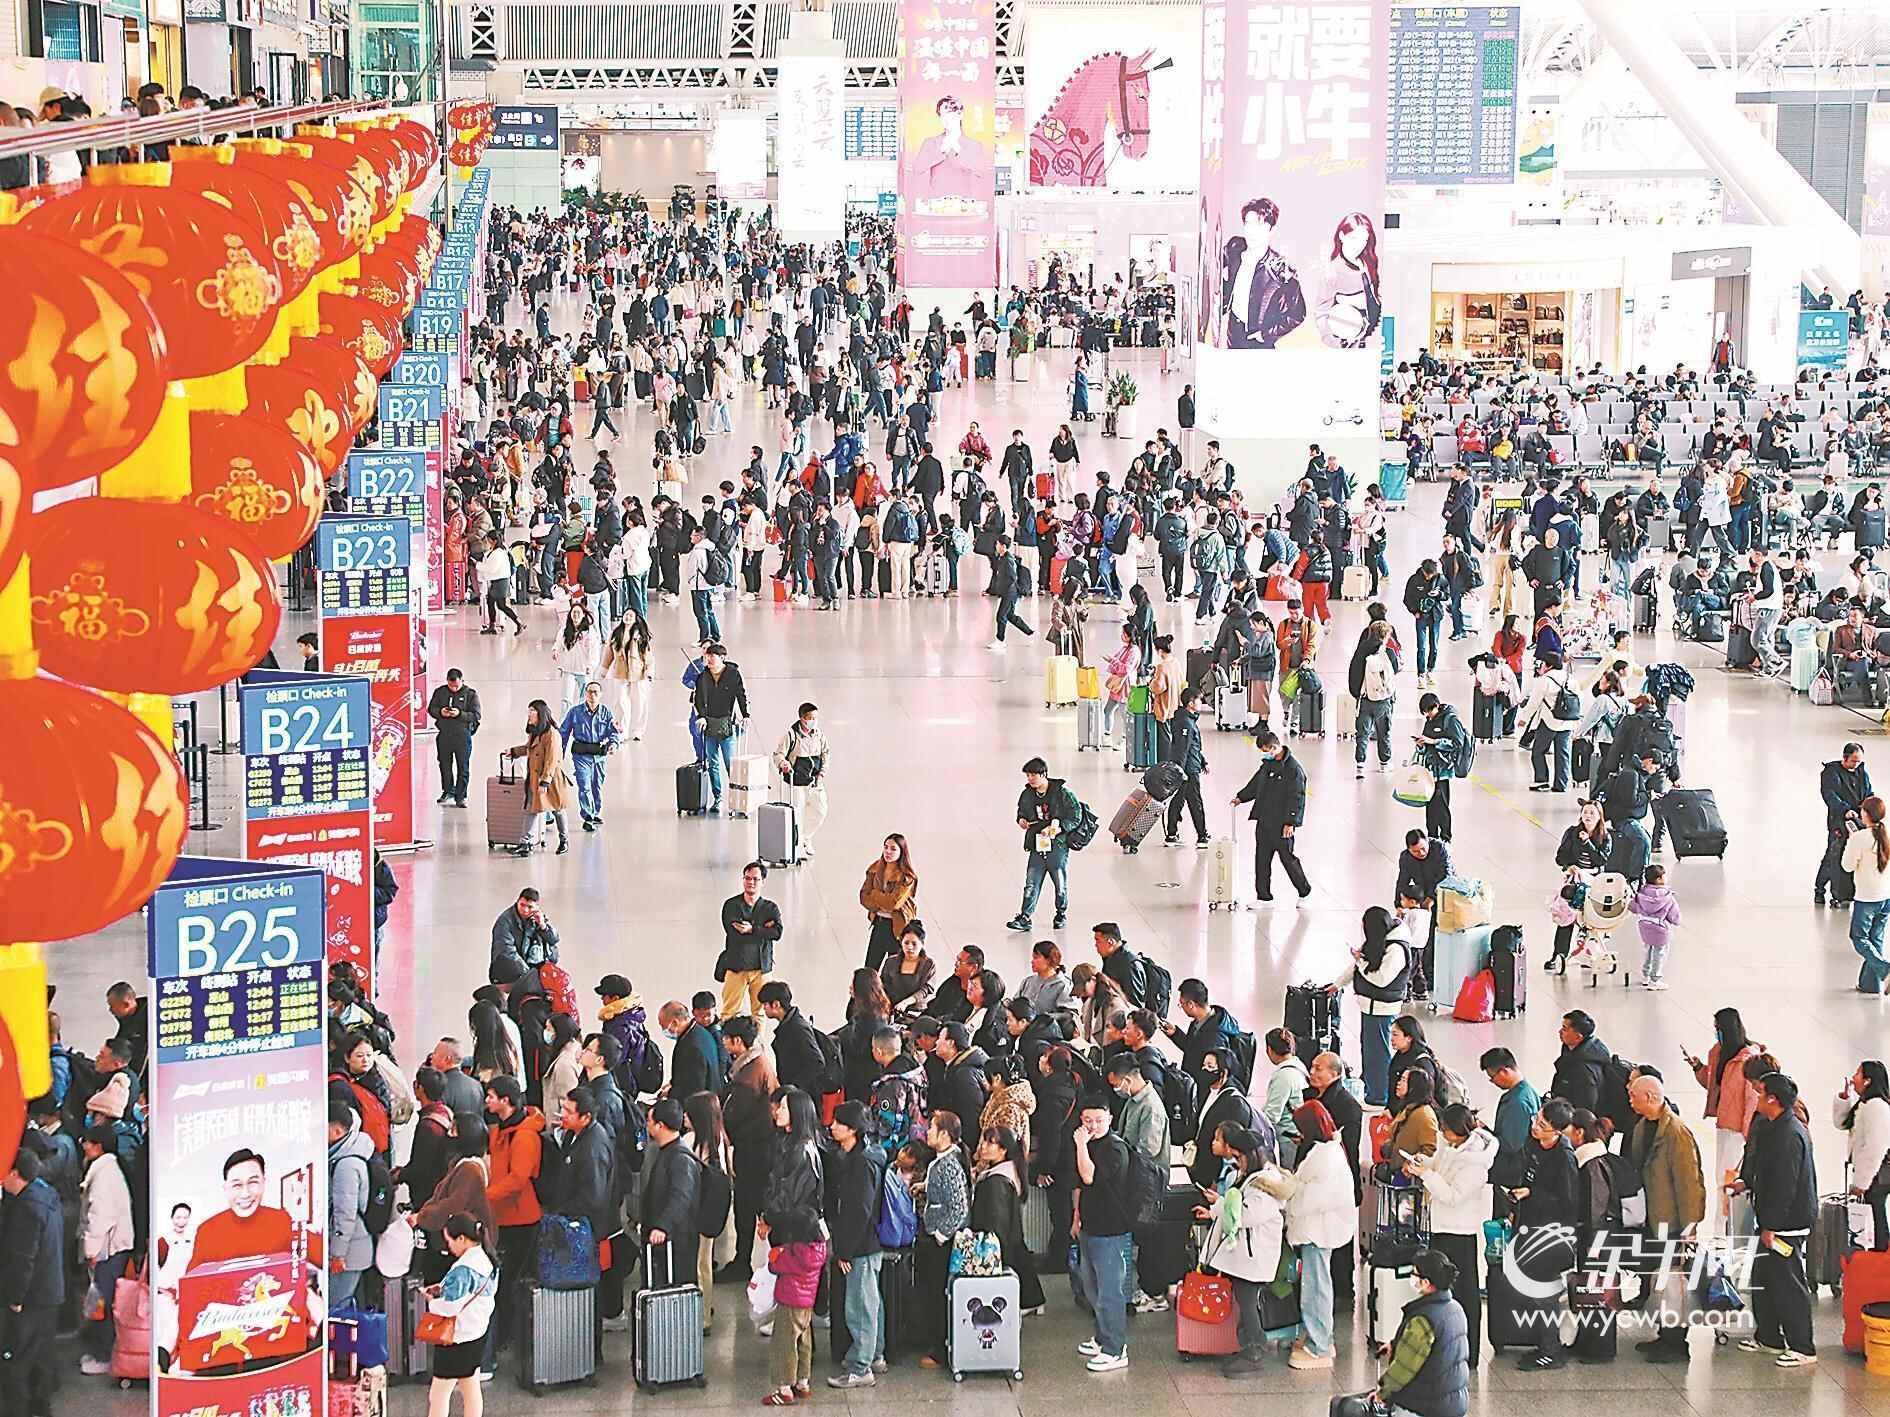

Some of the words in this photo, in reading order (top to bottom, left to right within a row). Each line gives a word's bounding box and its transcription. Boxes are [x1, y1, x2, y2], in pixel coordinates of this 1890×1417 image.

[1247, 6, 1372, 81] 就要
[1241, 82, 1371, 160] 小牛
[436, 275, 464, 290] B17
[419, 316, 452, 334] B19
[402, 364, 441, 384] B20
[388, 398, 430, 421] B21
[360, 467, 415, 498] B22
[361, 522, 394, 532] Check-in
[332, 536, 397, 572] B23
[59, 592, 107, 641] 福
[302, 687, 347, 700] Check-in
[262, 702, 354, 755] B24
[184, 888, 228, 908] 检票口
[232, 884, 293, 901] Check-in
[178, 906, 299, 977] B25
